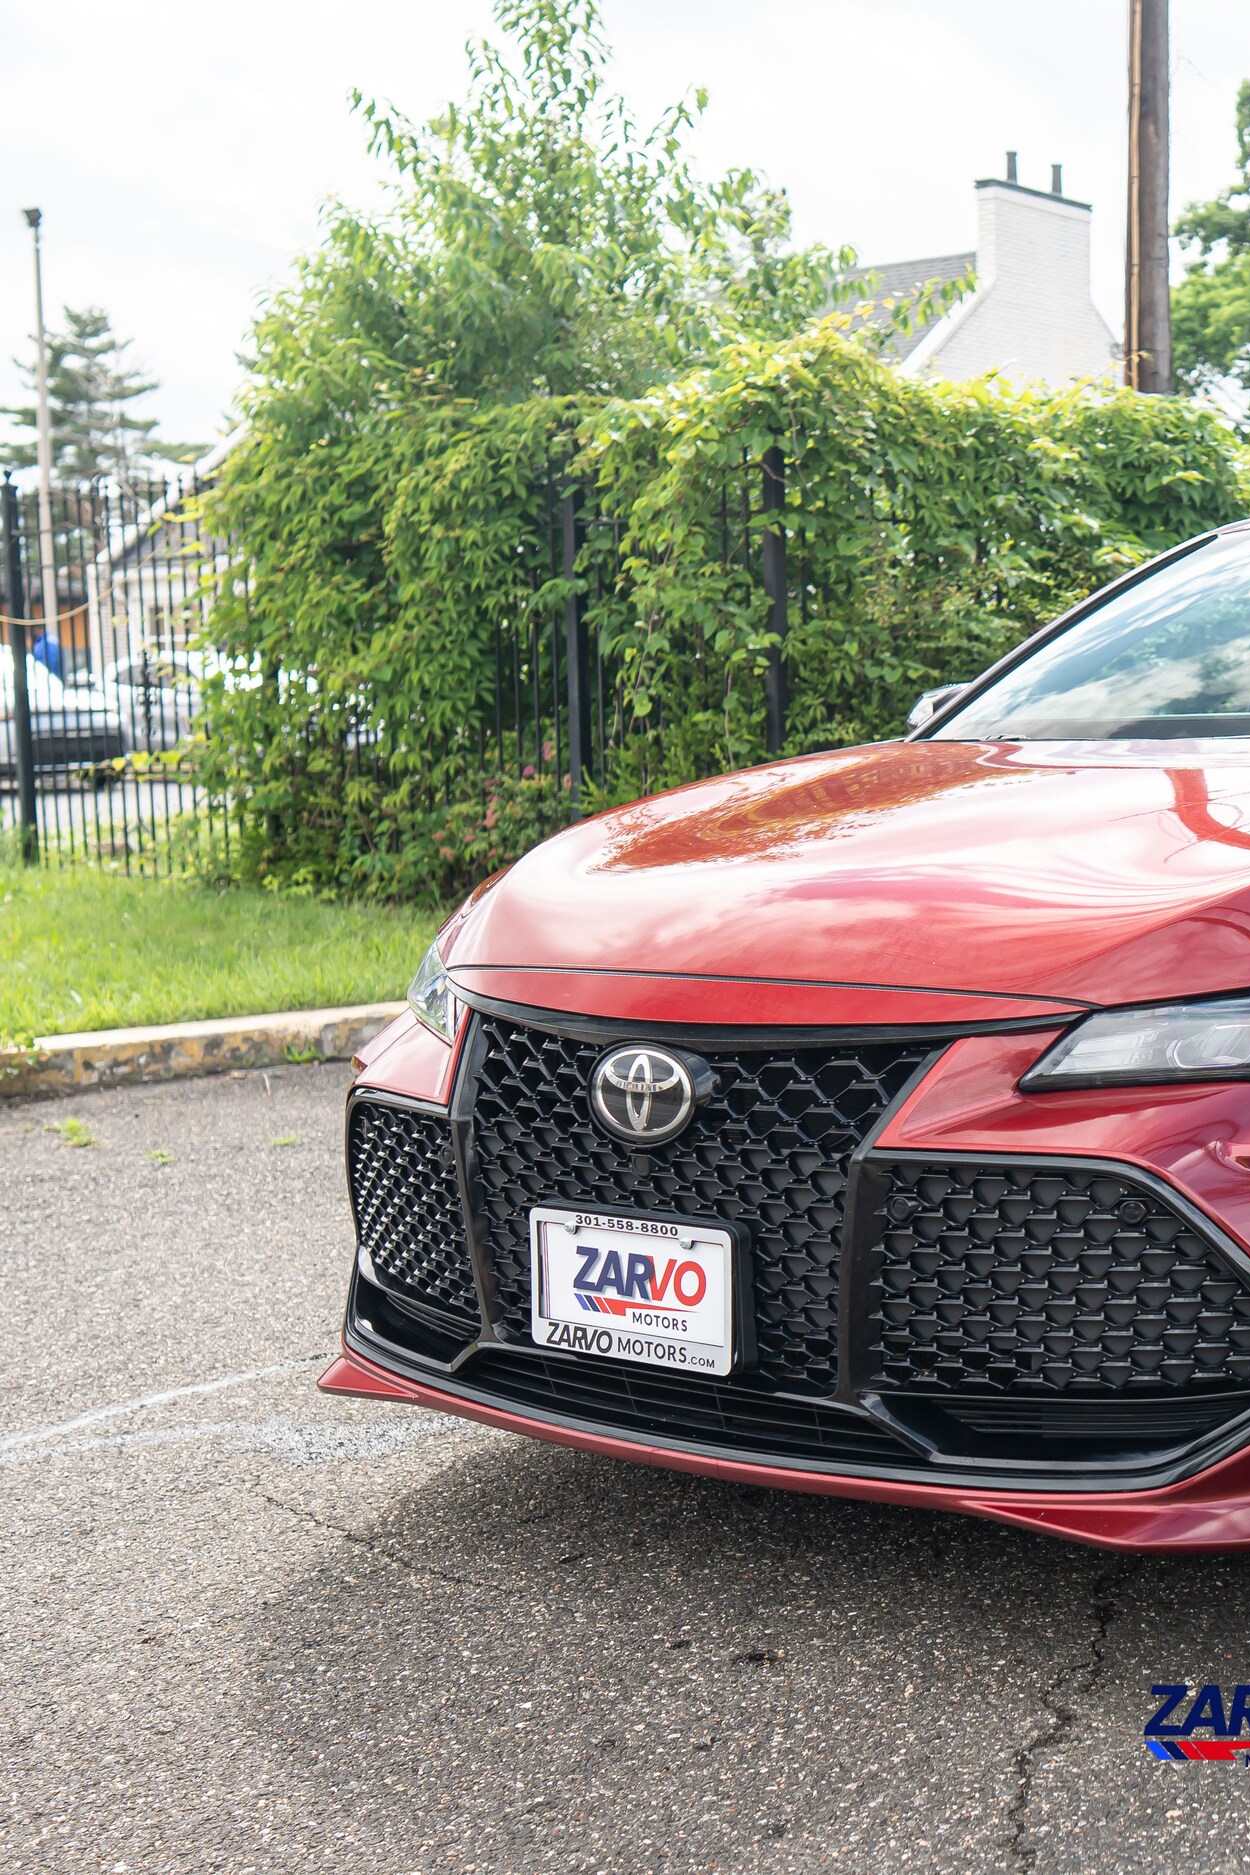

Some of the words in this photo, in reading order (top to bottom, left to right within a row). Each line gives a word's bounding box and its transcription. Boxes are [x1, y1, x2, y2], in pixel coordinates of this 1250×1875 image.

[575, 1214, 679, 1237] 301-558-8800
[573, 1245, 707, 1307] ZARVO
[632, 1311, 688, 1332] MOTORS
[546, 1322, 613, 1354] ZARVO
